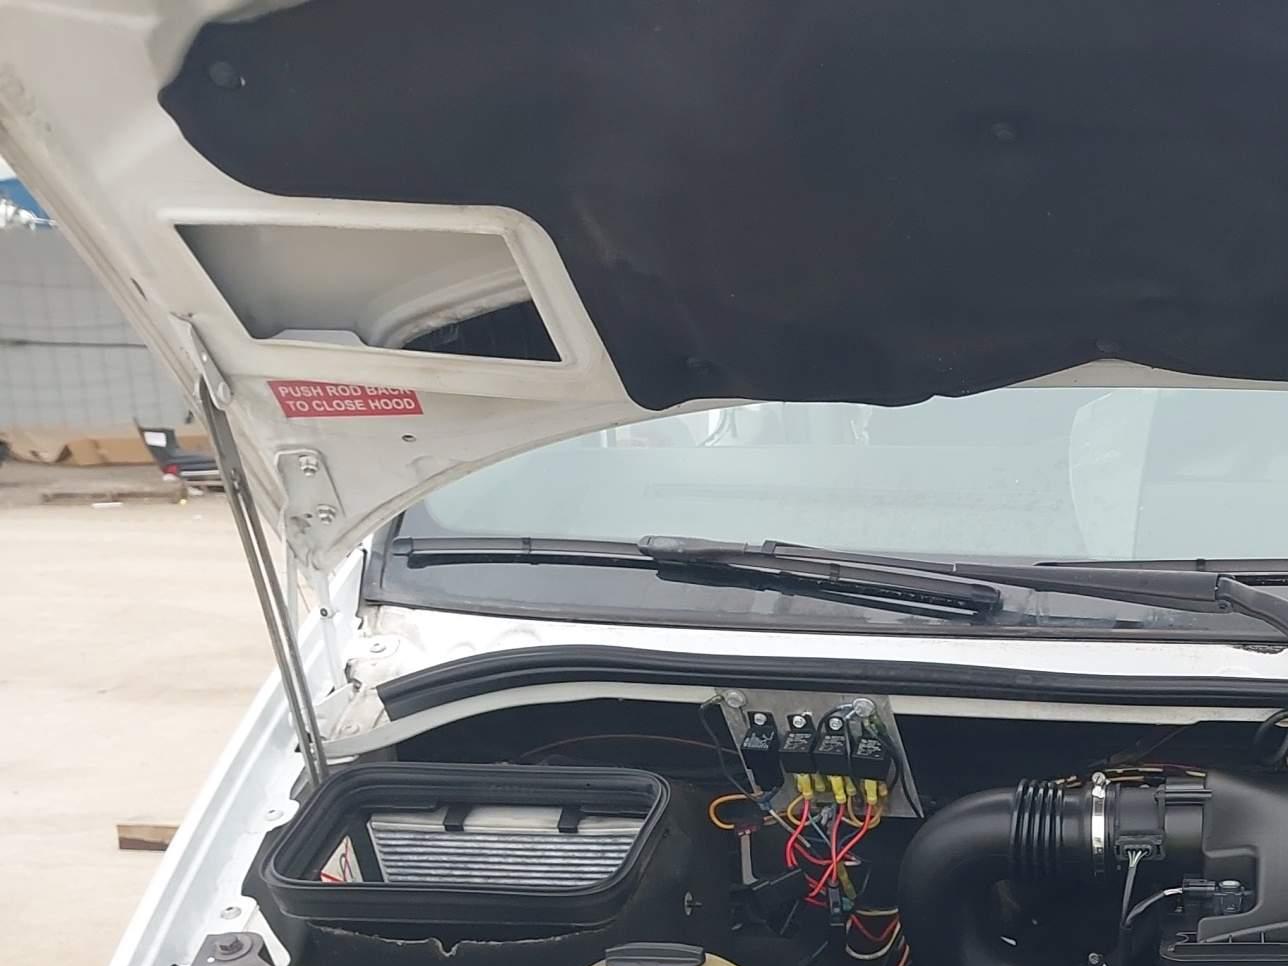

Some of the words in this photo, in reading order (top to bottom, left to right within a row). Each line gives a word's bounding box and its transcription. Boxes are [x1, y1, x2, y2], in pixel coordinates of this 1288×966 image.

[278, 386, 324, 397] PUSH
[326, 385, 362, 396] ROD
[285, 400, 309, 412] TO
[312, 399, 367, 411] CLOSE
[368, 398, 415, 410] HOOD
